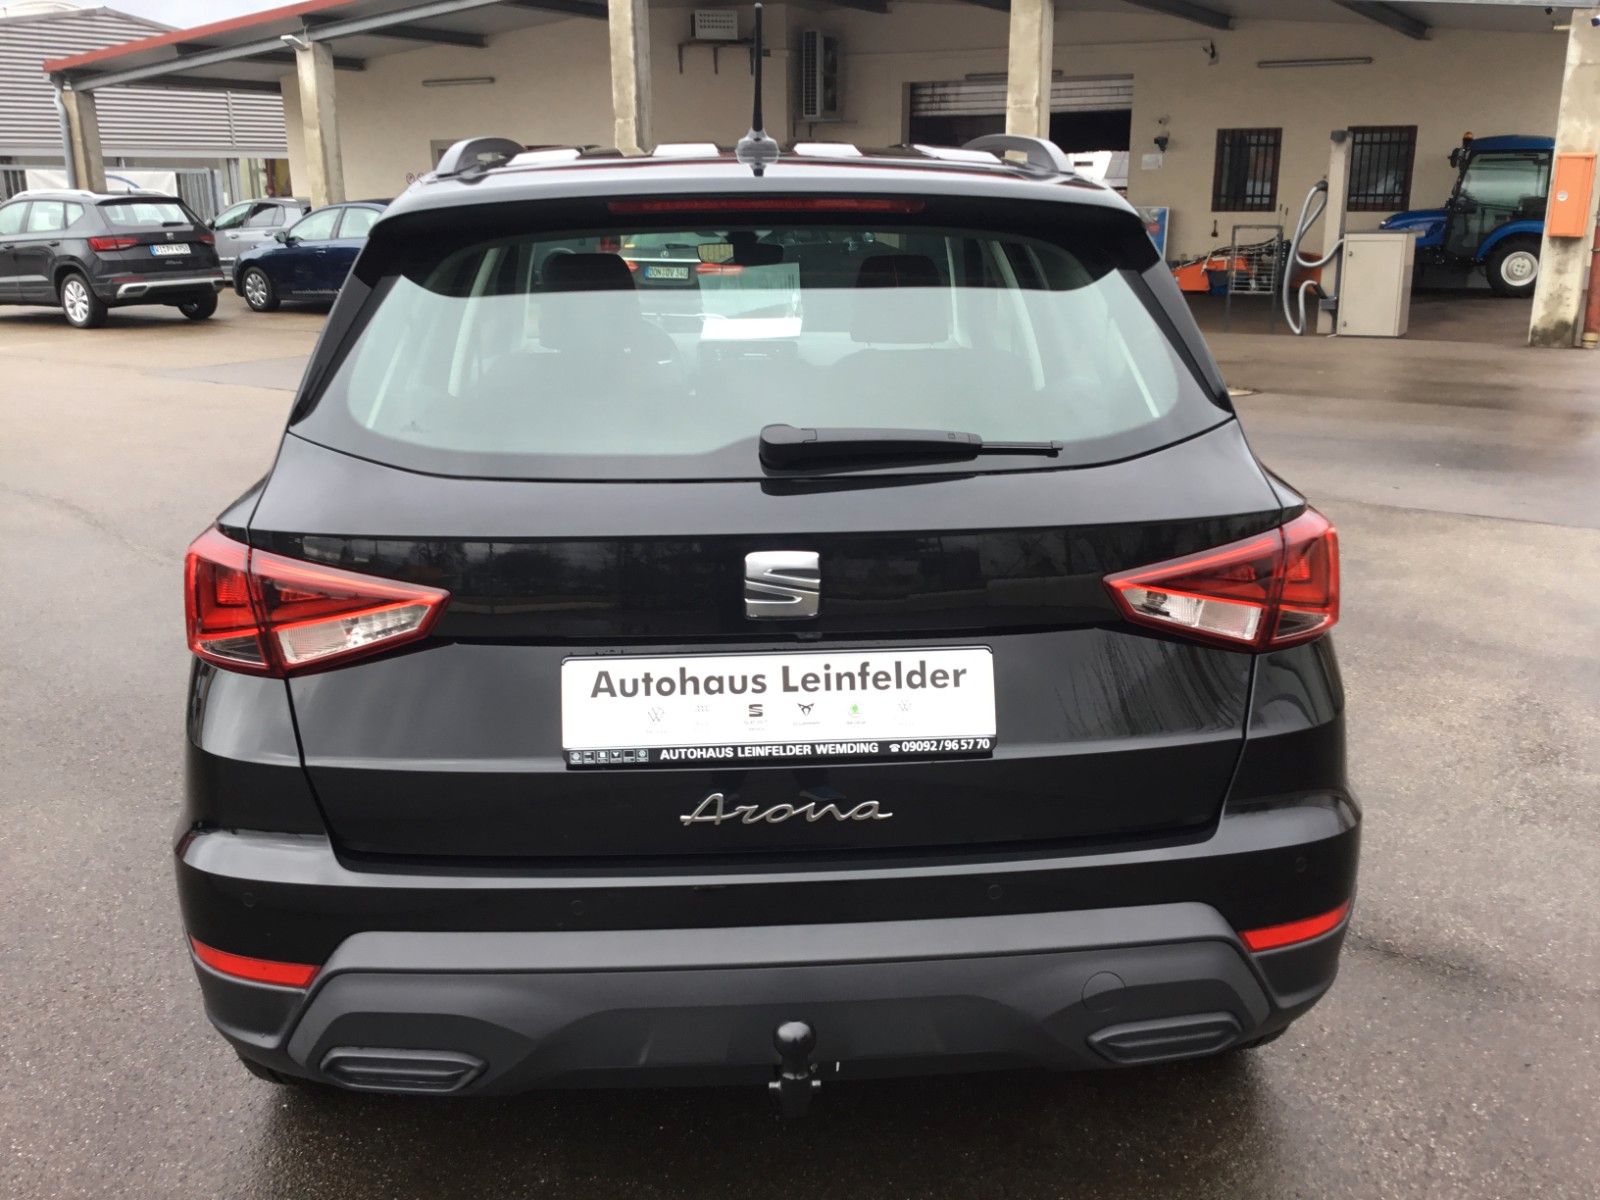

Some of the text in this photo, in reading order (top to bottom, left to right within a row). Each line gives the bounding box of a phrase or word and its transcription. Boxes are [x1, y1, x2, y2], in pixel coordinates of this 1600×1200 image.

[591, 660, 967, 698] Autohaus Leinfelder
[660, 747, 734, 760] AUTOHAUS
[737, 744, 812, 758] LEINFELDER
[815, 742, 879, 755] WEMDING
[680, 793, 893, 826] Arona
